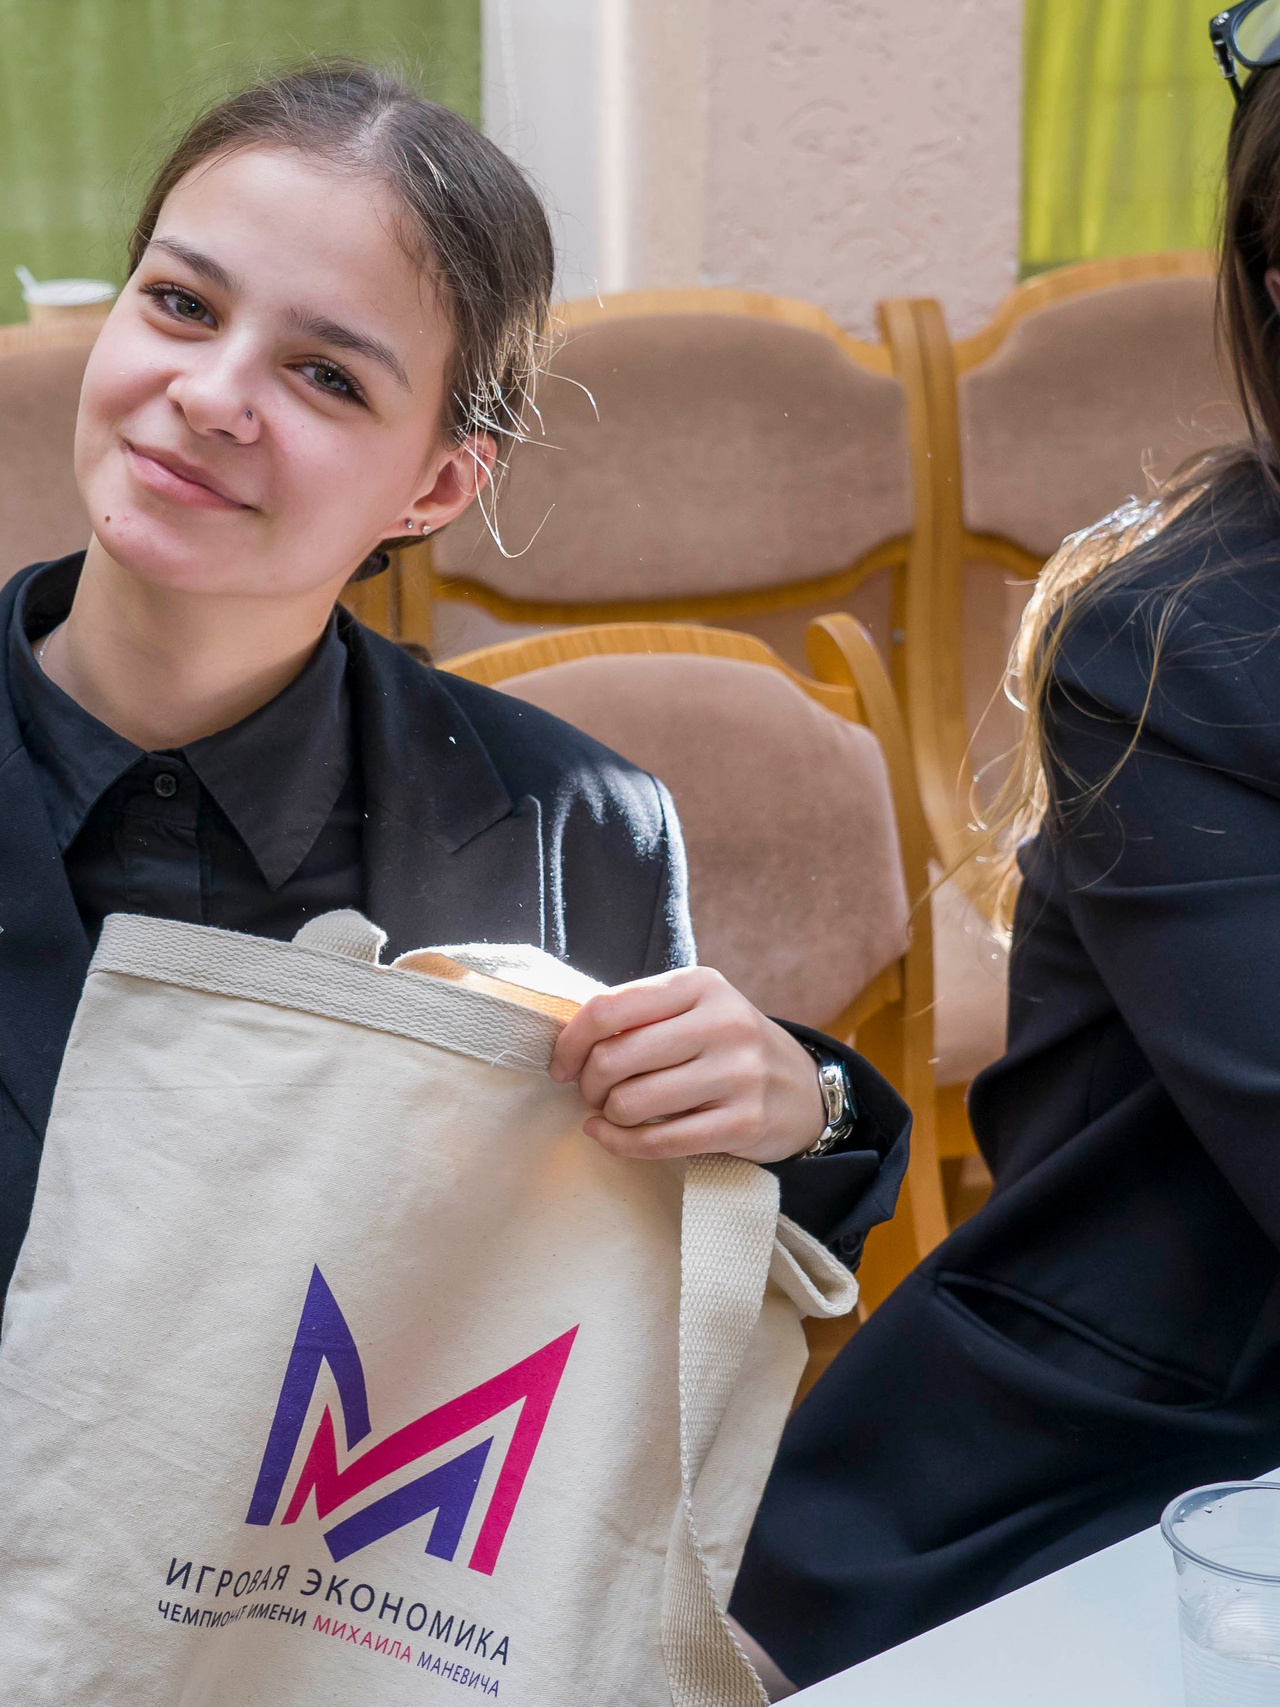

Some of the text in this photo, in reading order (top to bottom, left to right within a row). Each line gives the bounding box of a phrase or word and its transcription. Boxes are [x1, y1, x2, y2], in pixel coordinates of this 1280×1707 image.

[166, 1557, 509, 1665] ИГРОВАЯ ЭКОНОМИКА
[247, 1603, 307, 1627] ИМЕНИ
[312, 1615, 411, 1663] МИХАИЛА
[417, 1651, 500, 1698] МАНЕВИЧА
